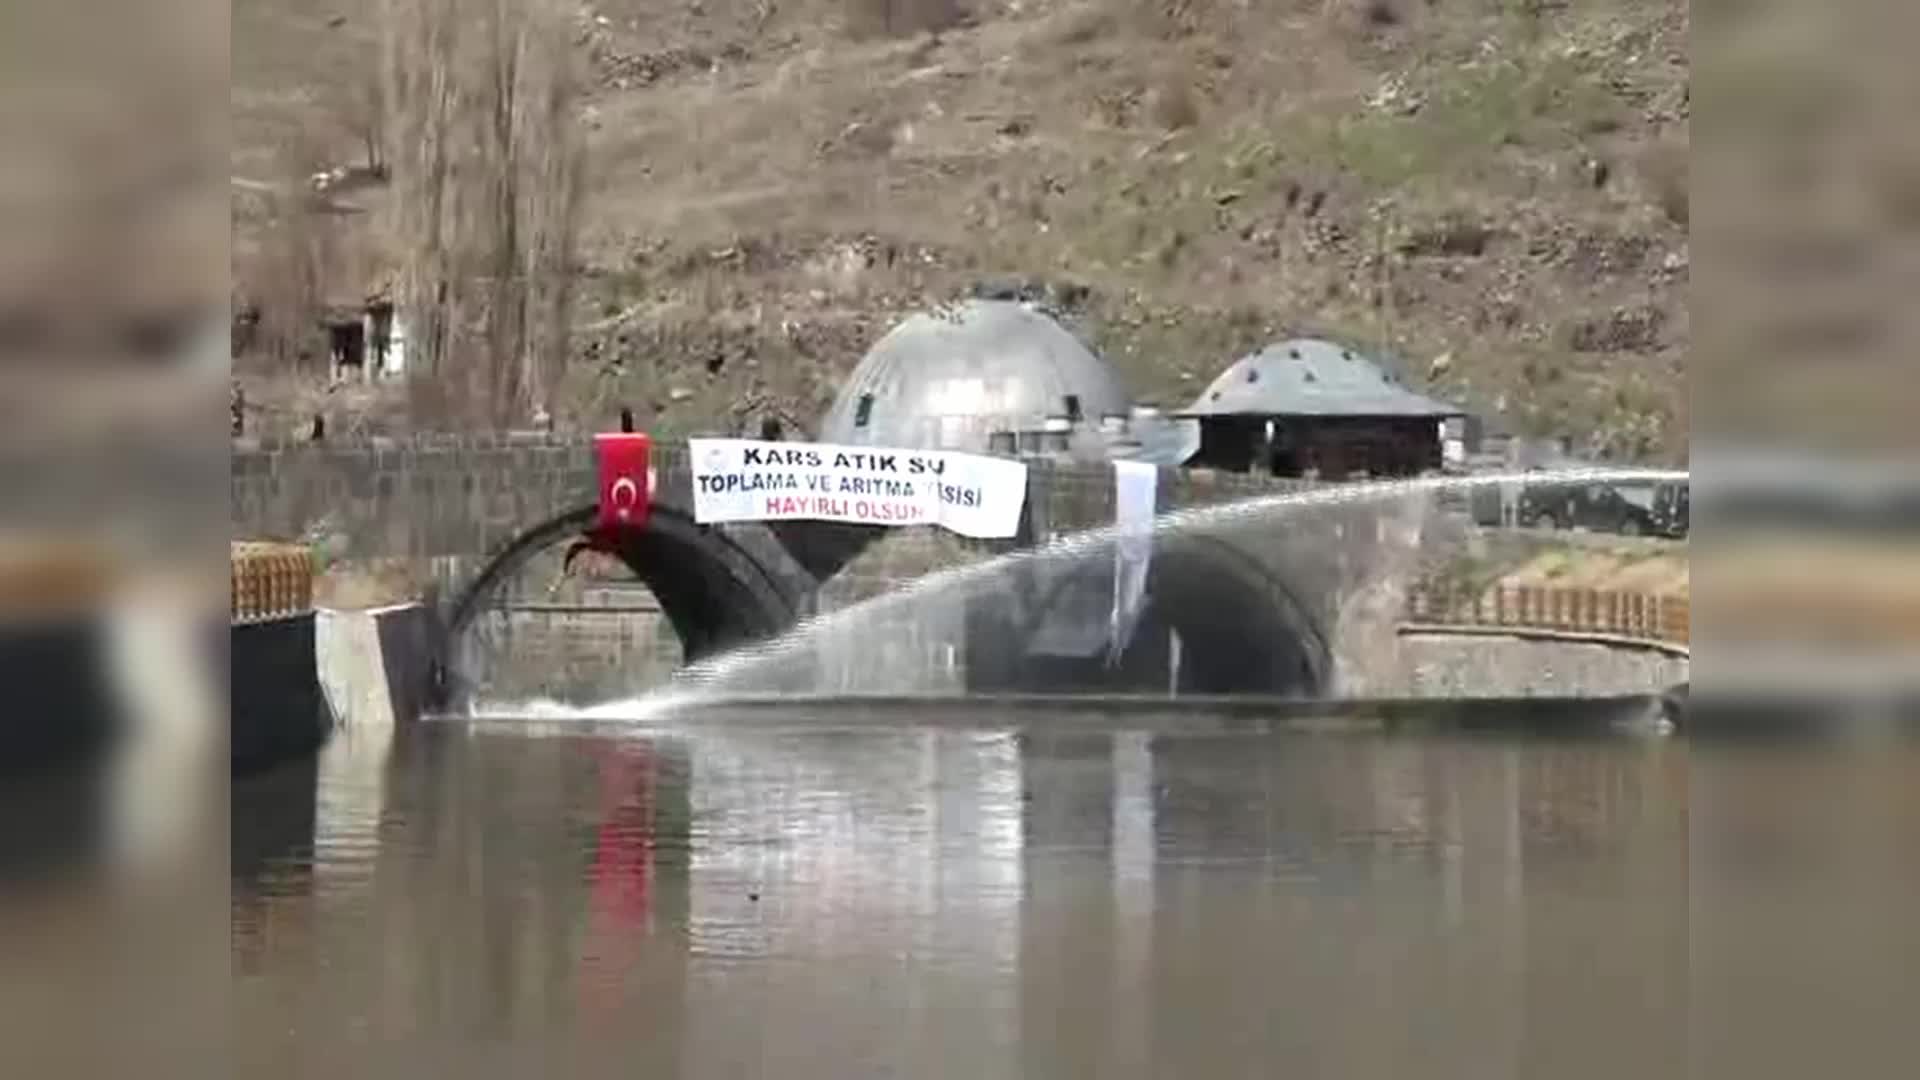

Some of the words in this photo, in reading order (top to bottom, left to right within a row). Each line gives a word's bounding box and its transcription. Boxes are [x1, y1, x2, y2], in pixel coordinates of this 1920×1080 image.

[744, 448, 822, 467] KARS
[834, 453, 897, 472] ATIK
[909, 457, 945, 475] SU
[698, 473, 798, 494] TOPLAMA
[806, 475, 831, 492] VE
[839, 477, 915, 496] ARITMA
[766, 497, 848, 516] HAYIRLI
